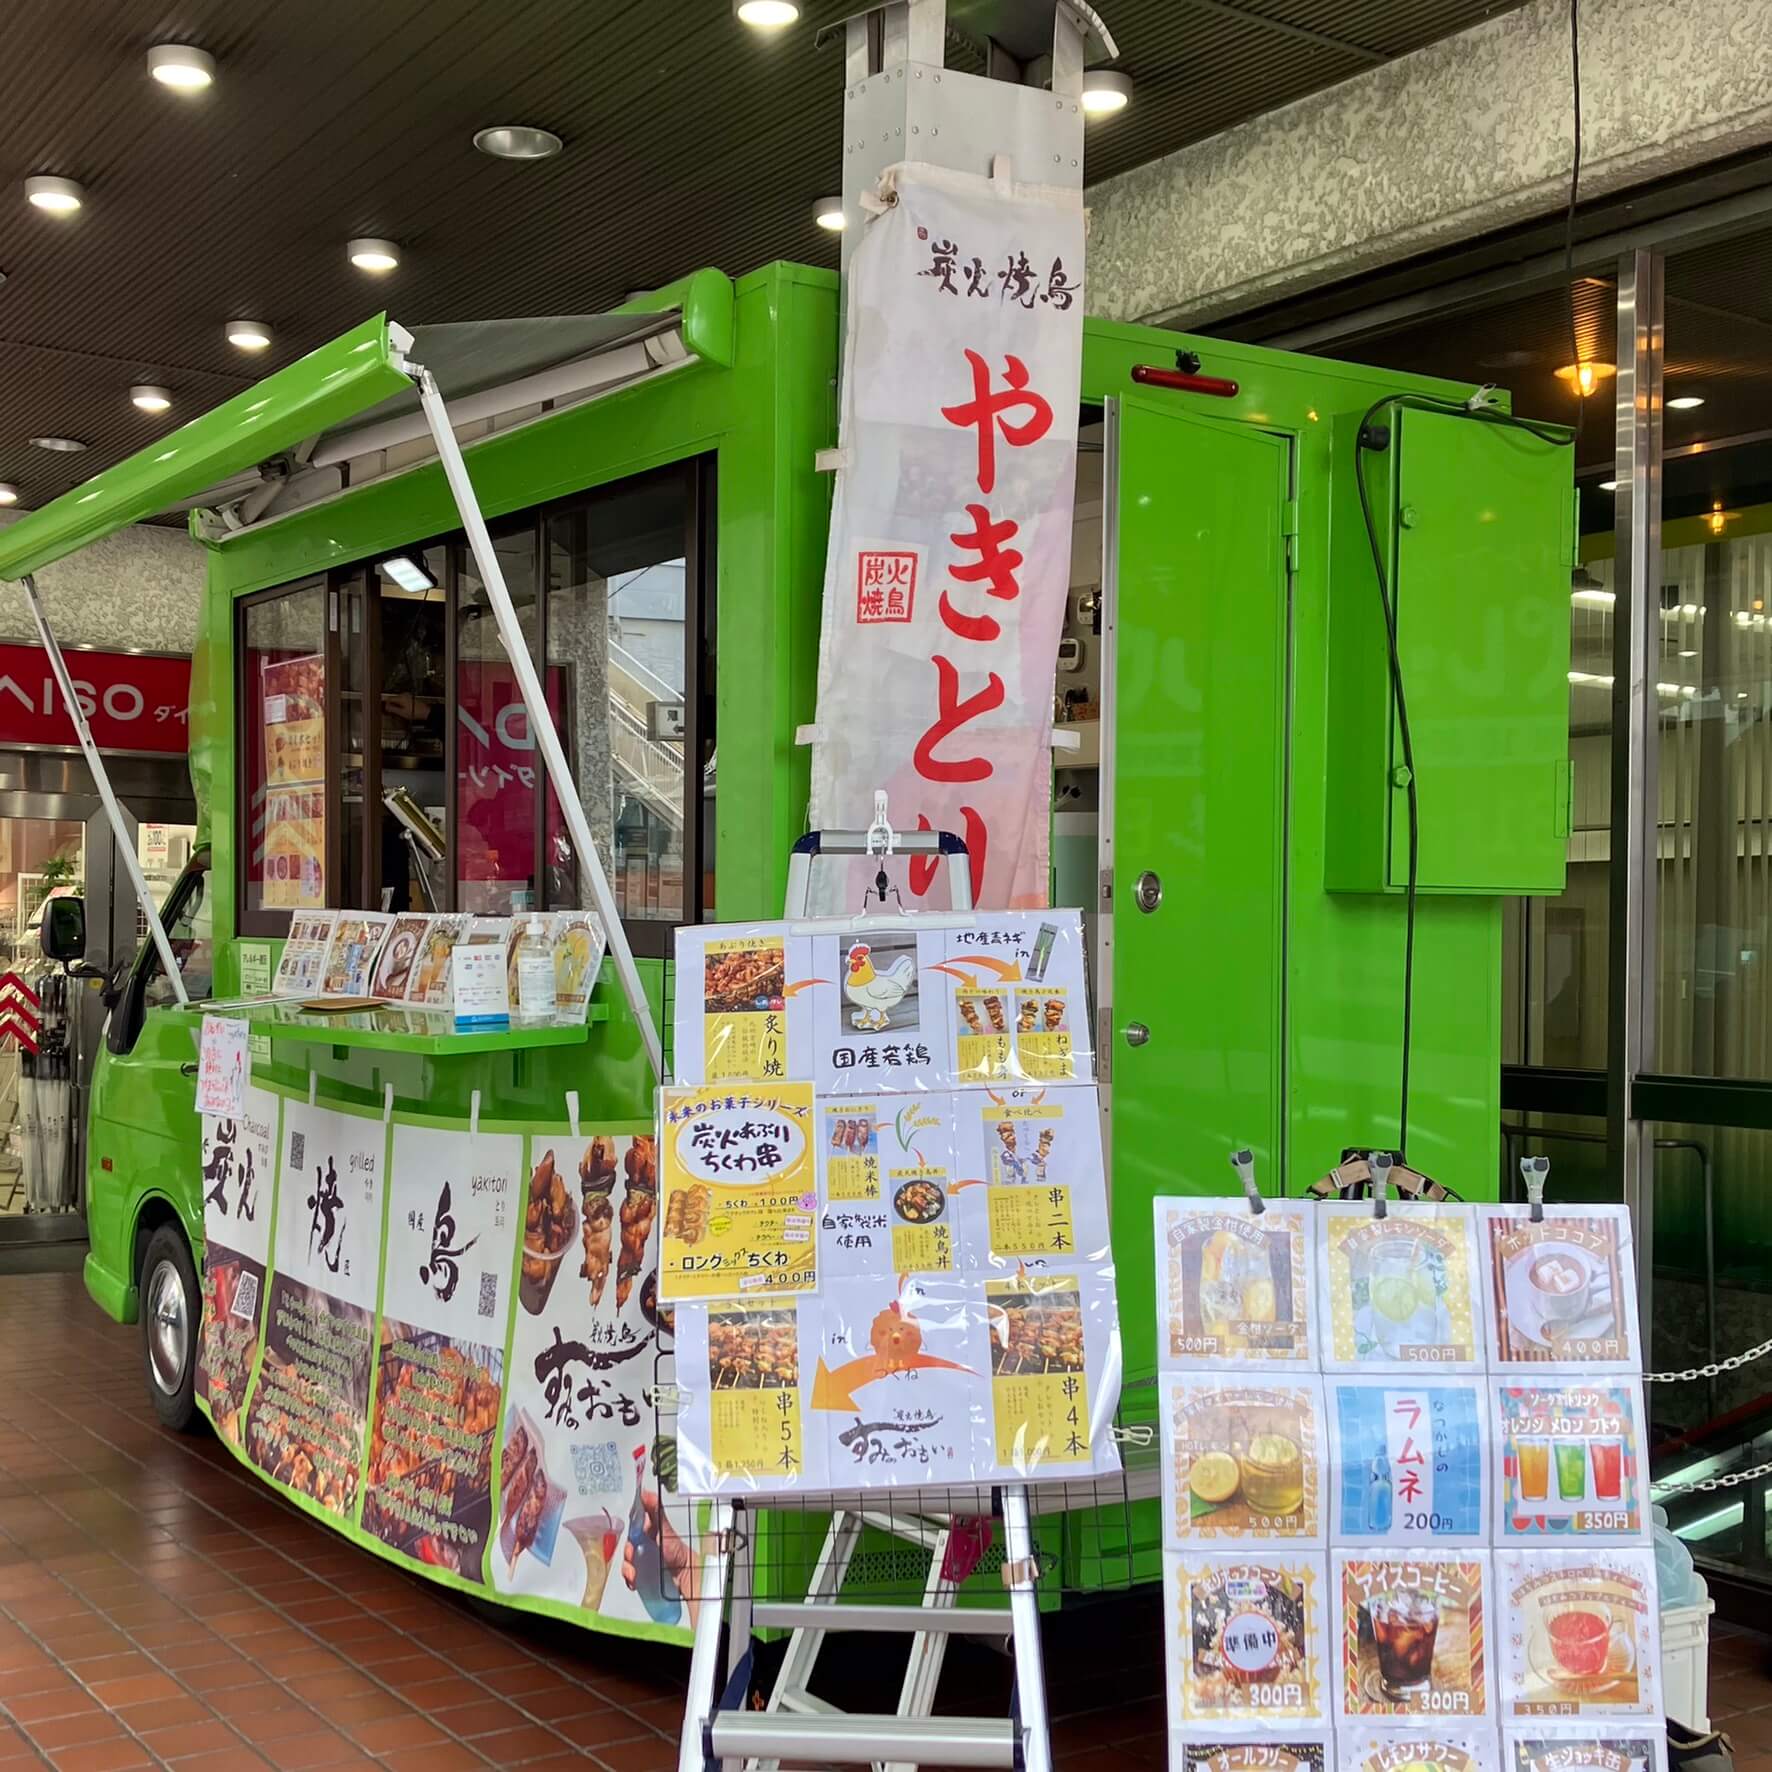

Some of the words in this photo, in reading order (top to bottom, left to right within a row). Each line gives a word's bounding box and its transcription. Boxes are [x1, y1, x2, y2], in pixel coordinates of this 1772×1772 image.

[917, 240, 1081, 310] 炭火焼鳥
[864, 558, 909, 587] 炭火
[862, 587, 905, 616] 焼鳥
[909, 348, 1054, 909] やきとり
[1015, 948, 1030, 958] in
[763, 1014, 784, 1077] 炙り焼
[832, 1043, 932, 1069] 国産若鶏
[692, 1122, 790, 1149] 炭火あぶり
[350, 1150, 376, 1174] grilled
[701, 1143, 783, 1173] ちくわ串
[471, 1174, 509, 1197] yakitori
[726, 1199, 748, 1208] ちくわ
[822, 1213, 888, 1231] 自家製米
[1047, 1187, 1072, 1251] 串二本
[420, 1181, 481, 1302] 鳥
[836, 1235, 873, 1249] 使用
[934, 1225, 950, 1271] 焼鳥丼
[1506, 1226, 1604, 1251] ホットココア
[831, 1333, 848, 1344] in
[1177, 1336, 1218, 1351] 500円
[1562, 1339, 1619, 1354] 400円
[1408, 1347, 1456, 1361] 500円
[1061, 1376, 1089, 1456] 串4本
[1551, 1417, 1584, 1434] メロン
[776, 1391, 800, 1470] 串5本
[1393, 1399, 1425, 1504] ラムネ
[1248, 1516, 1298, 1528] 500円
[1403, 1512, 1454, 1531] 200円
[1584, 1512, 1629, 1530] 350円
[1356, 1566, 1463, 1599] アイスコーヒー
[1225, 1630, 1277, 1654] 準備中
[1249, 1684, 1303, 1706] 300円
[1421, 1691, 1470, 1711] 300円
[1523, 1703, 1573, 1716] 350円
[1217, 1746, 1289, 1771] オールフリー
[1377, 1743, 1459, 1769] レモンサワー
[1545, 1748, 1622, 1770] 生ジョッキ缶
